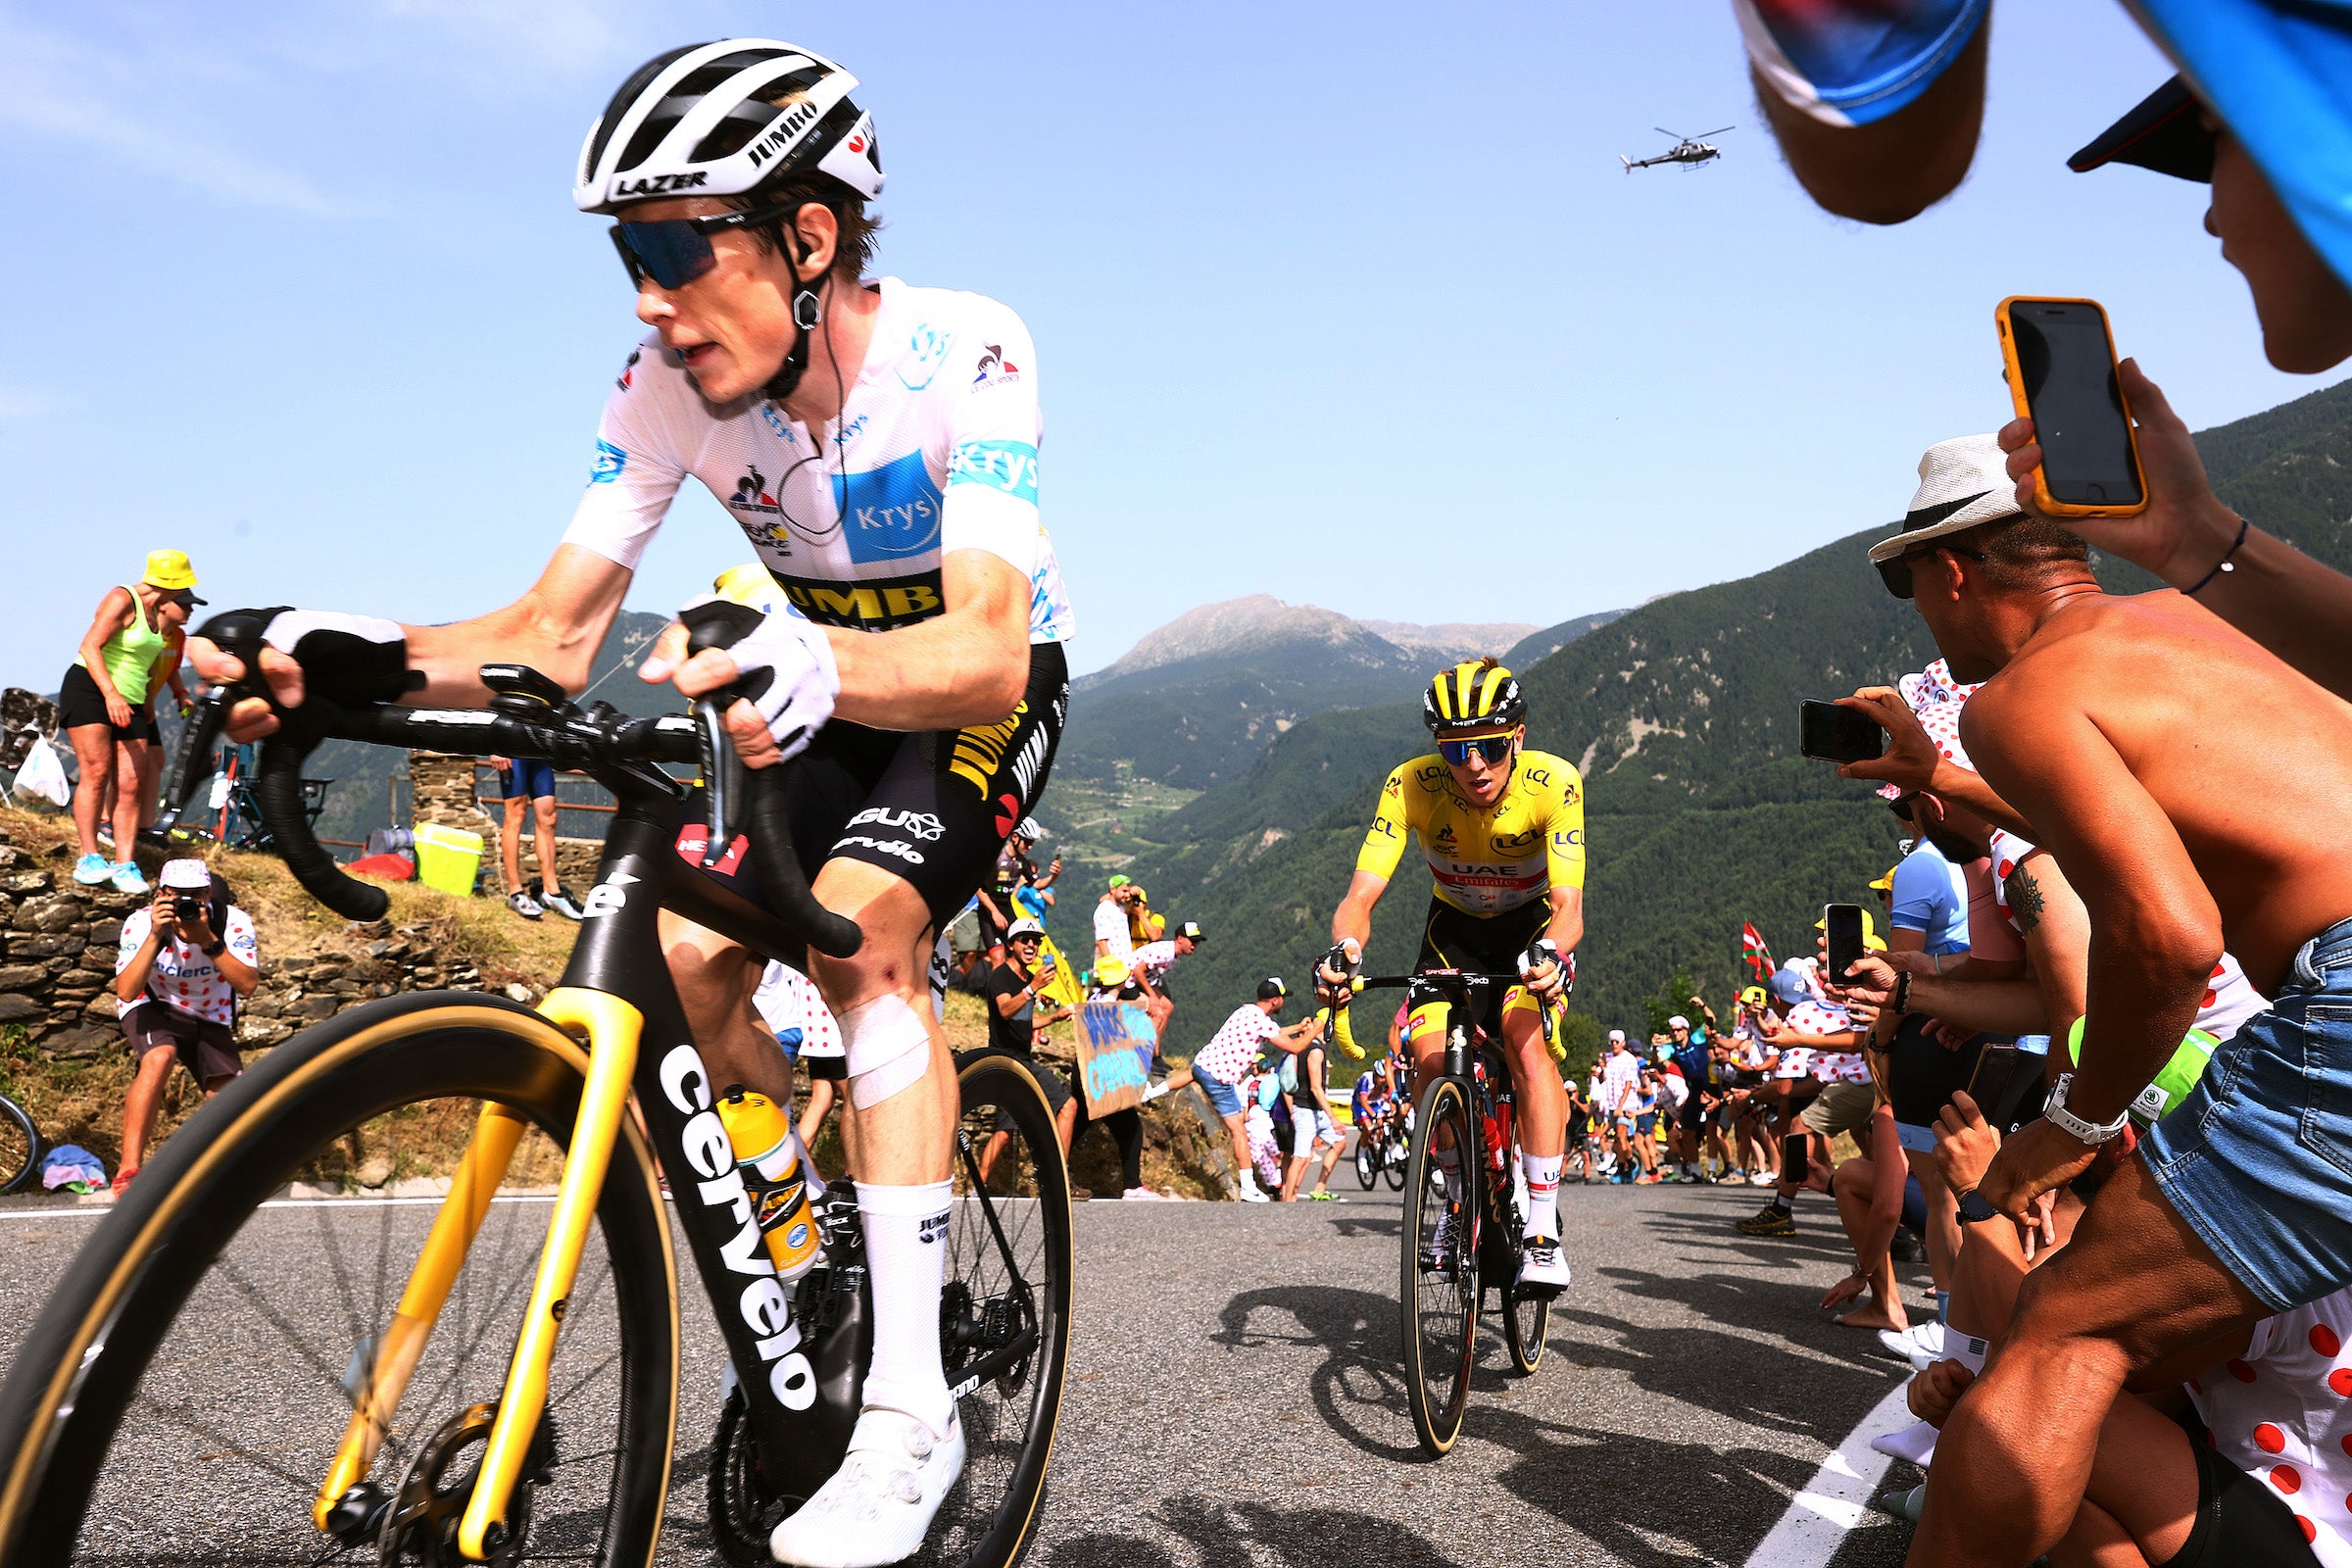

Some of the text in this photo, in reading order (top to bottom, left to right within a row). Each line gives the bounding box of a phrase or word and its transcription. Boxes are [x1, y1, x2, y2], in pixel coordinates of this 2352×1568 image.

[748, 101, 818, 169] JUMBO
[616, 172, 708, 195] LAZER
[856, 499, 931, 530] Krys
[786, 585, 941, 619] UMB
[1526, 768, 1550, 788] LCL
[1453, 798, 1469, 815] LCL
[1493, 805, 1512, 819] LCL
[1495, 828, 1546, 849] LCL
[1452, 864, 1518, 875] UAE
[1455, 877, 1519, 886] Emirates
